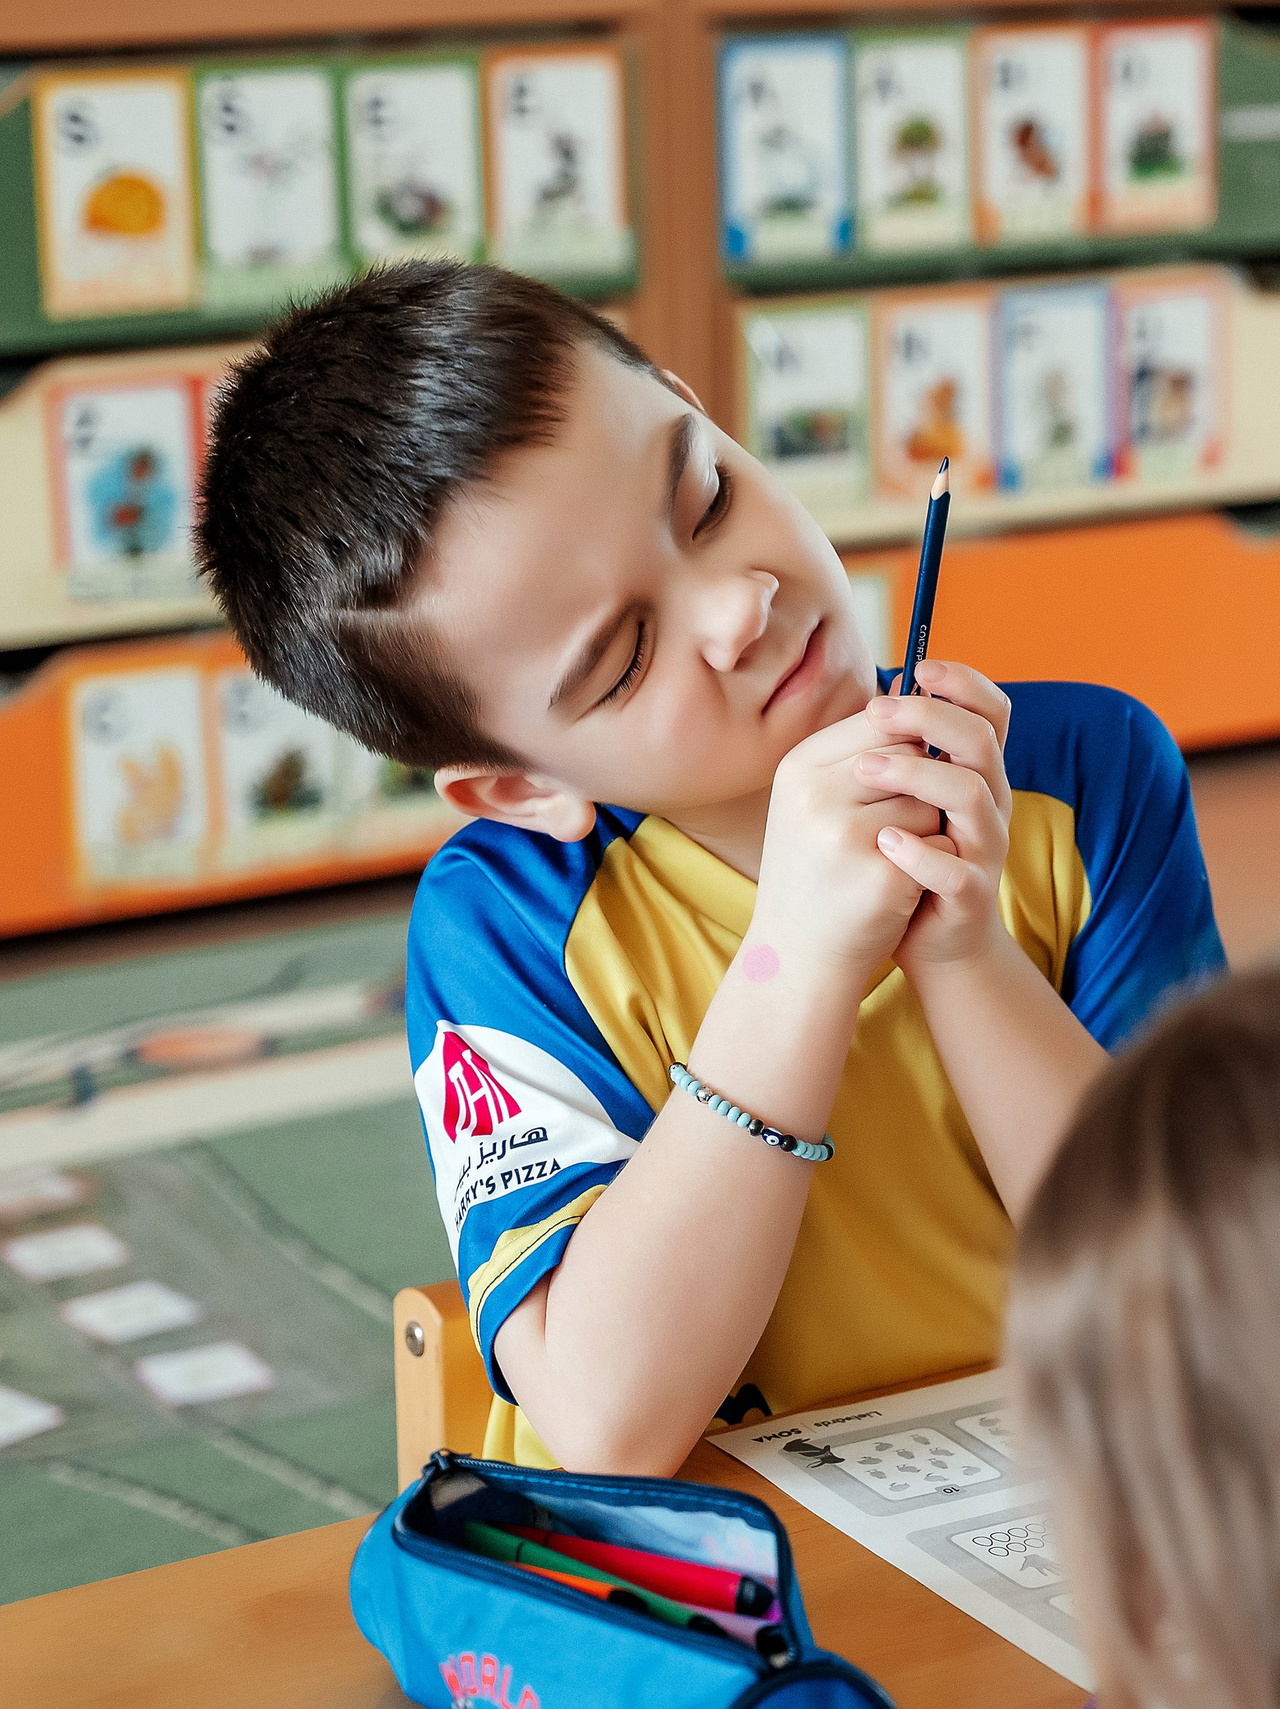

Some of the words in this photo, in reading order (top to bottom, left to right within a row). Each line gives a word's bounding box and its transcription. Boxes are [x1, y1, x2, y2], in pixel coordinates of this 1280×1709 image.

[500, 1157, 562, 1190] PIZZA
[751, 1427, 803, 1443] SOMA
[942, 1486, 960, 1495] 10
